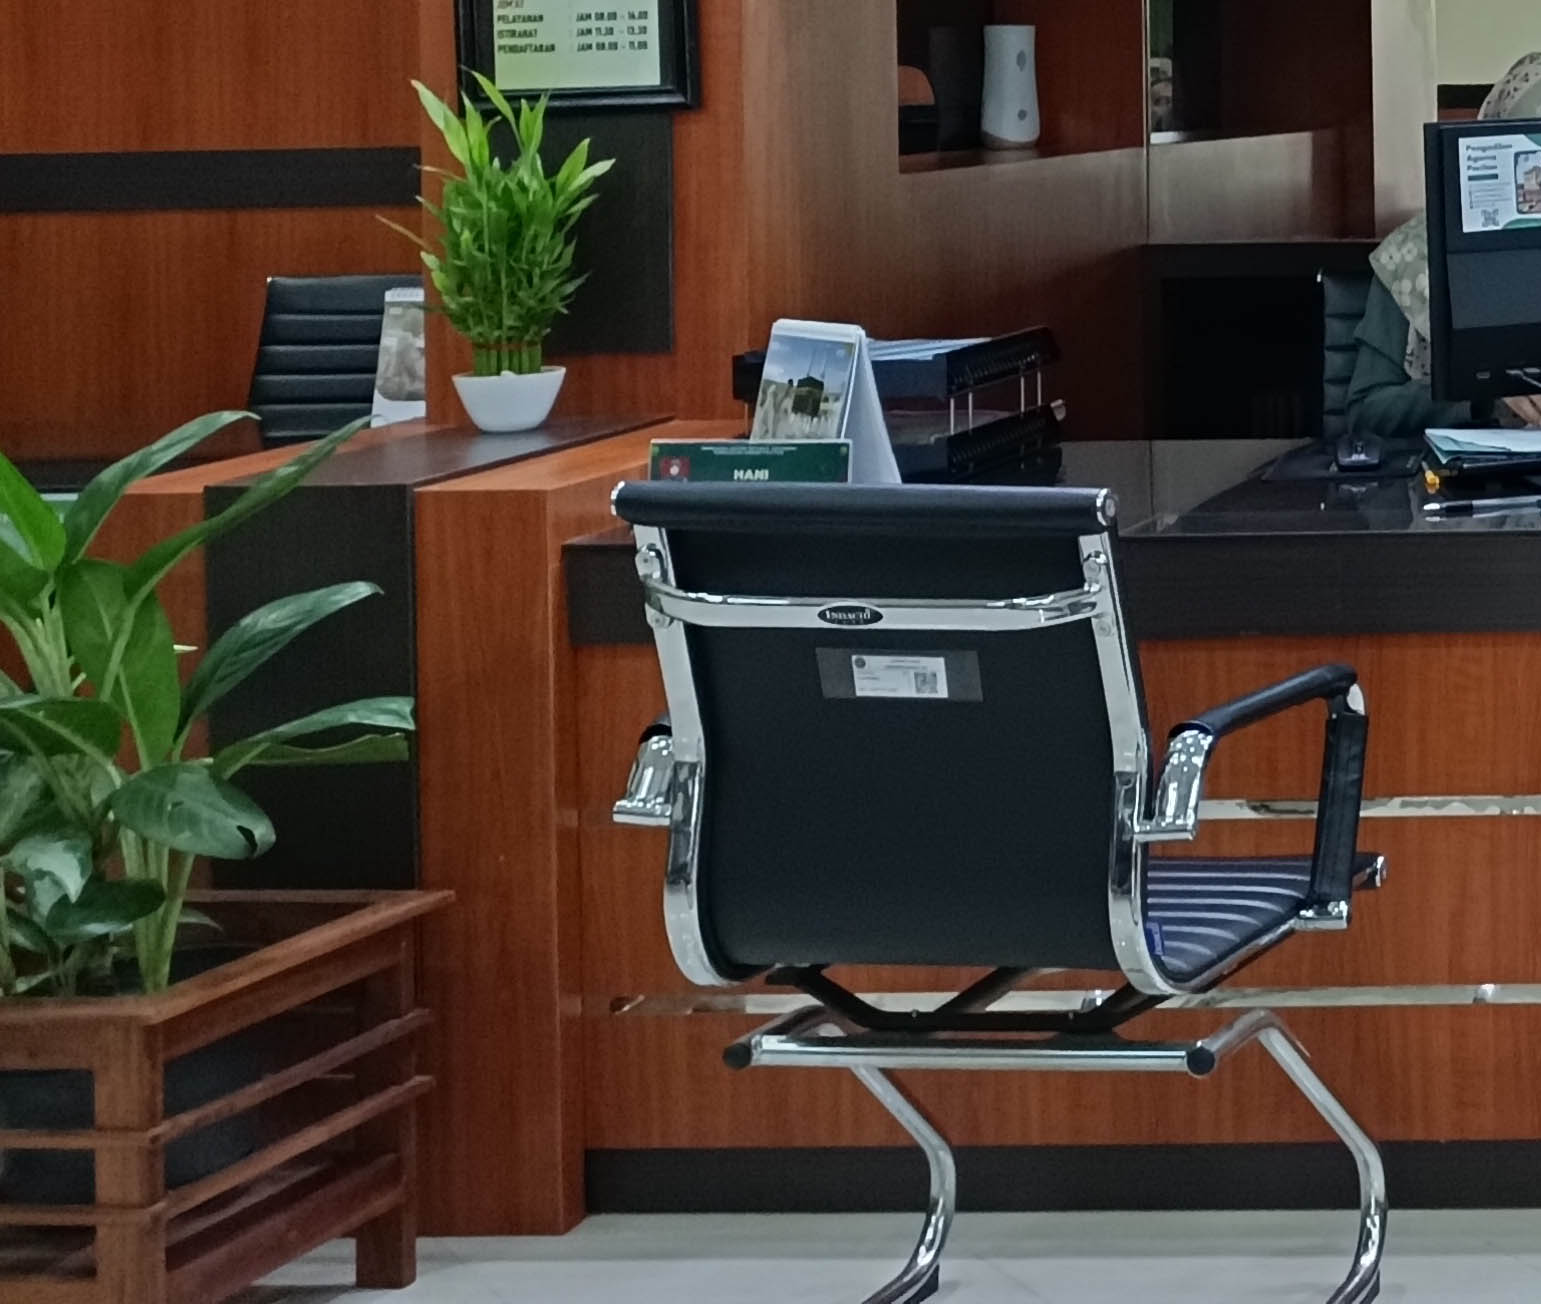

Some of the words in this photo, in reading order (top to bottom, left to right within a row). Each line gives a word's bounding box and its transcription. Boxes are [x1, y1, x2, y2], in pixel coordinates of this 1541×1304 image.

[576, 13, 593, 23] JAM
[577, 28, 593, 38] JAM
[577, 43, 593, 53] JAM
[734, 469, 769, 481] HANI
